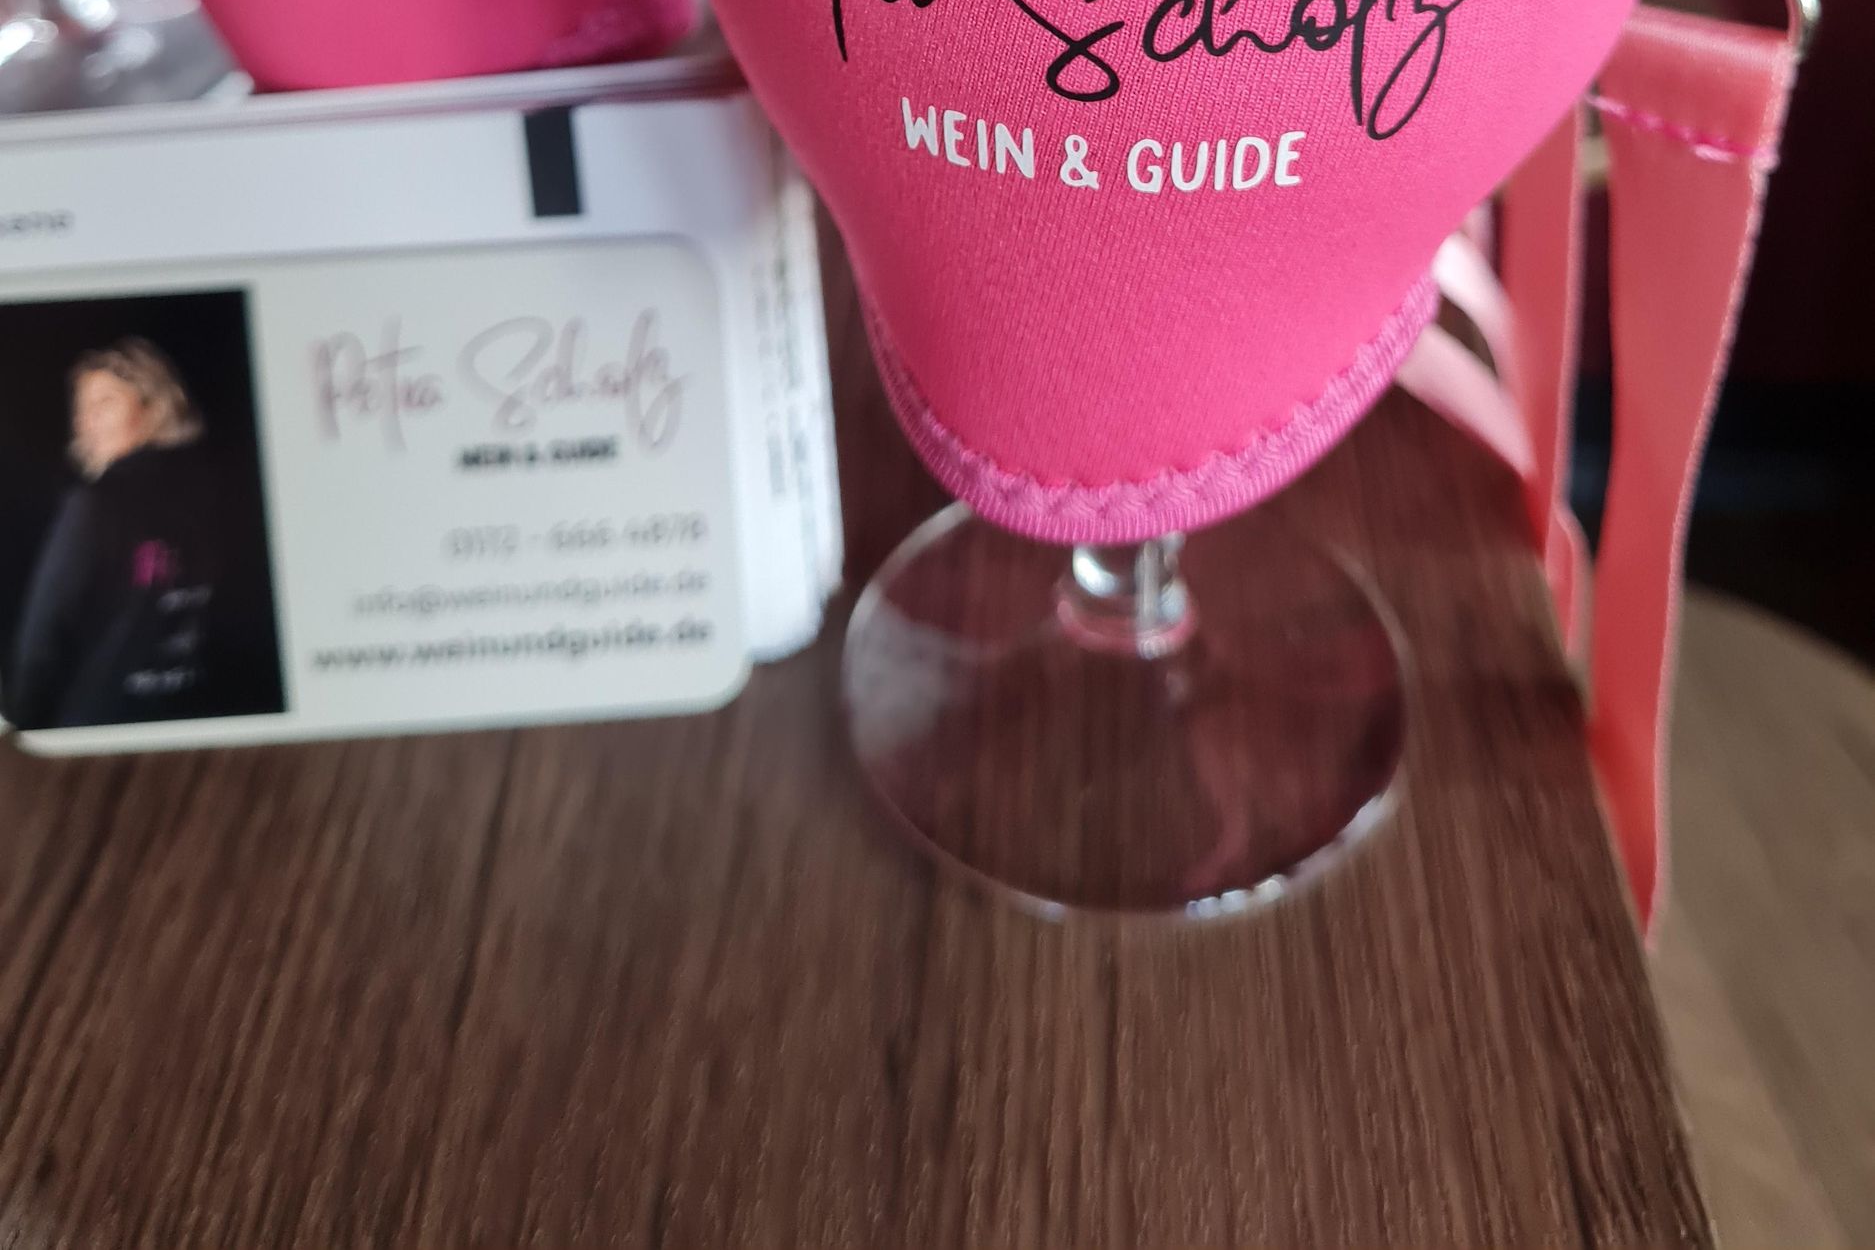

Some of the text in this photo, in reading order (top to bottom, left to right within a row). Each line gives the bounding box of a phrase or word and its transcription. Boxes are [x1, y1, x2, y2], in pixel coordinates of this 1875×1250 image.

[901, 96, 1306, 194] WEIN & GUIDE
